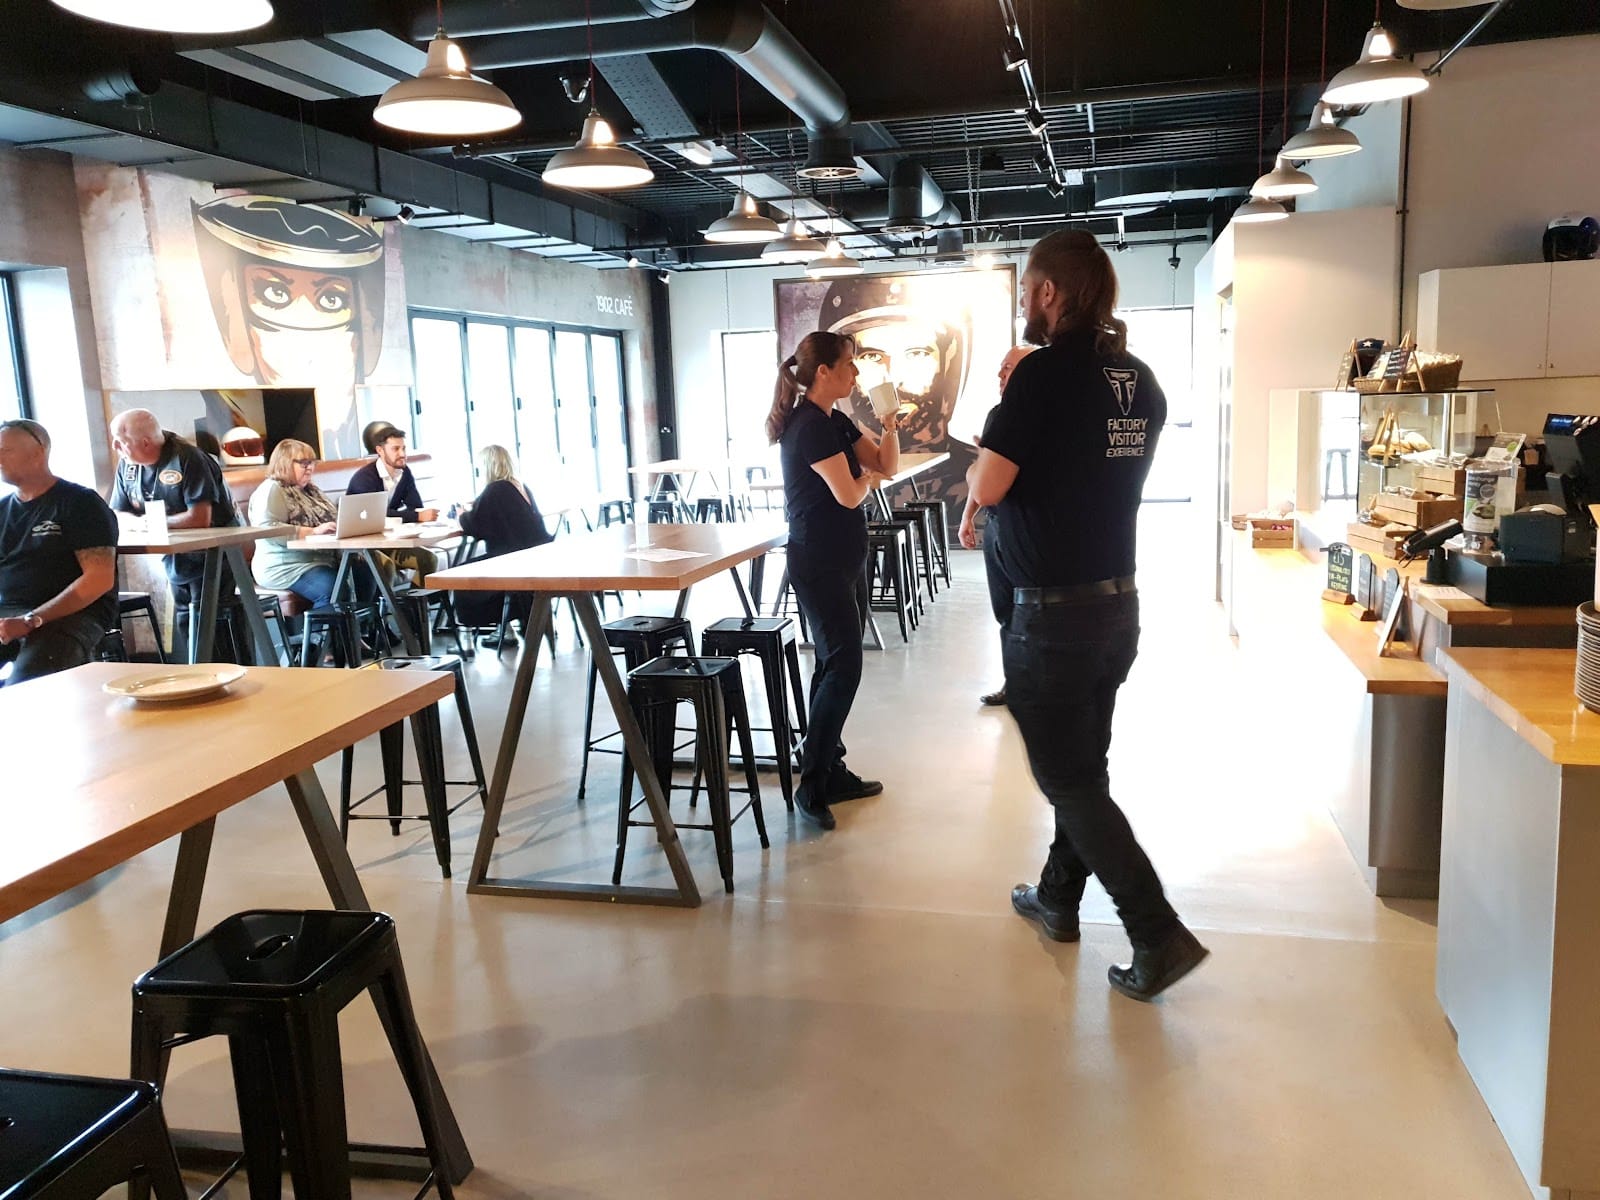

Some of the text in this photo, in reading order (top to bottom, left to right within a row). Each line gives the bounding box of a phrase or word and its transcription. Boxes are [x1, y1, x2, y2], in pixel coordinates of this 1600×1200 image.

[596, 295, 633, 316] 1902 CAFÉ
[1107, 418, 1148, 431] FACTORY
[1108, 432, 1147, 446] VISITOR
